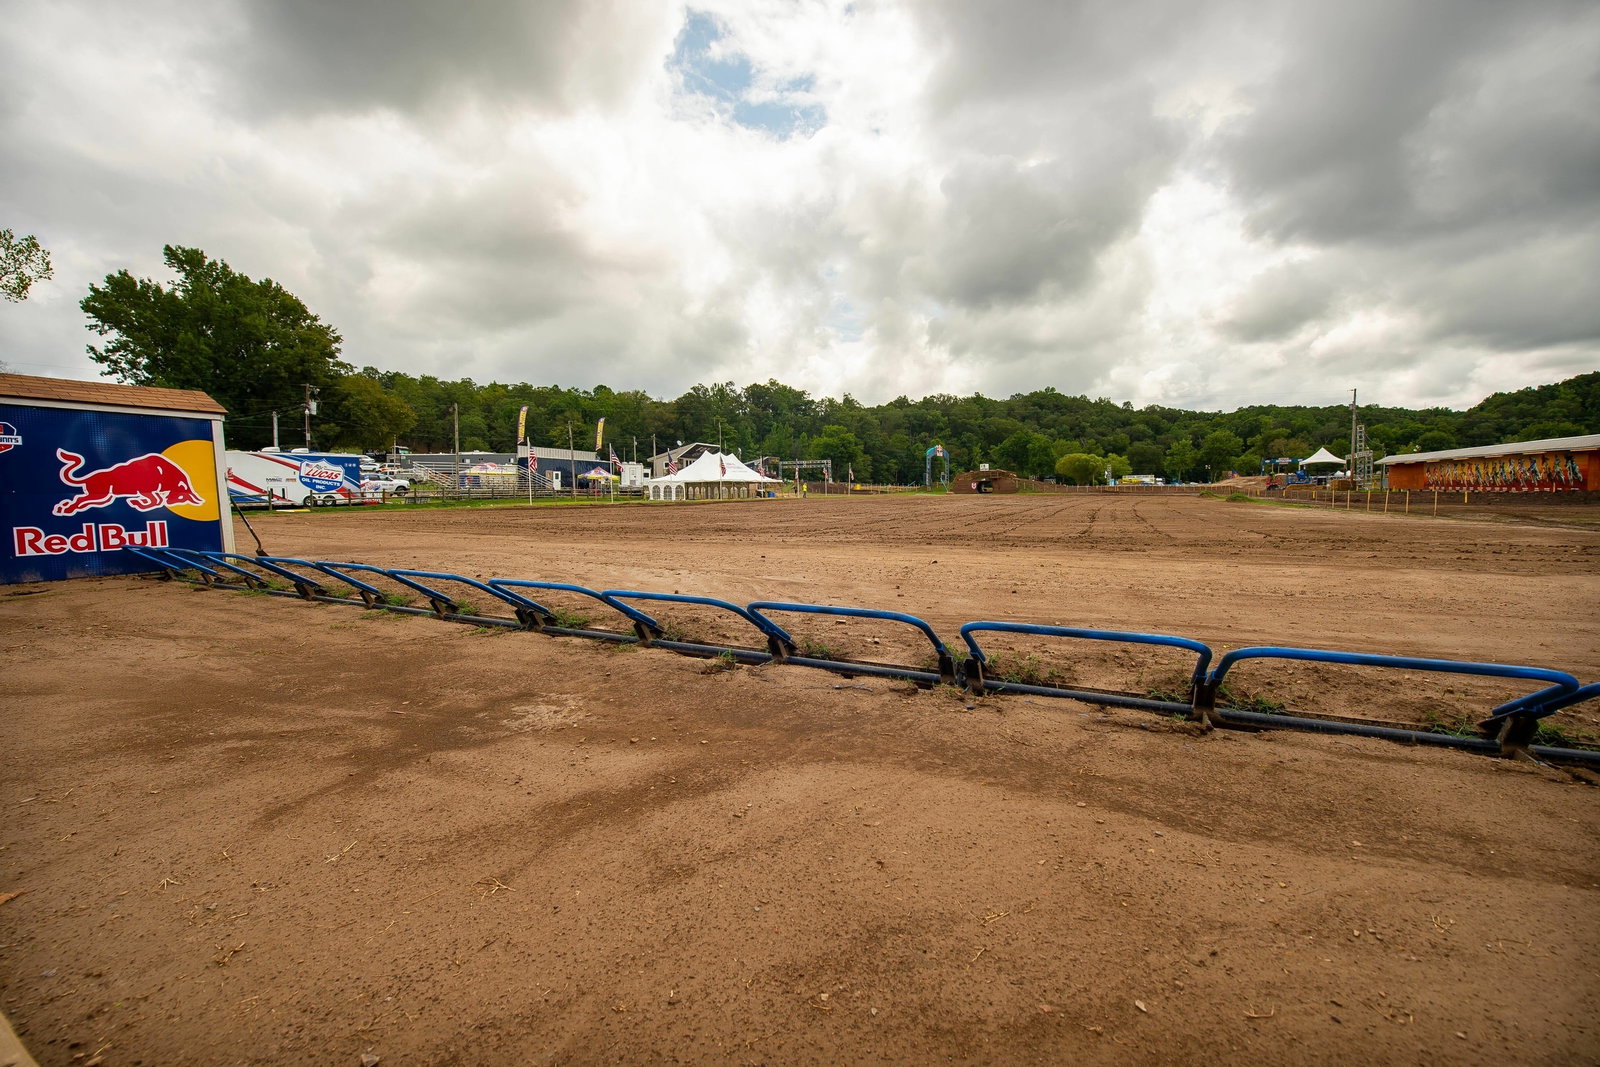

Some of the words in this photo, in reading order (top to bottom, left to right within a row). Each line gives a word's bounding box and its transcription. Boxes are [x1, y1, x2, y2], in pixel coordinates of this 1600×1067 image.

[305, 469, 341, 479] LUCAS
[13, 523, 97, 556] Red
[99, 520, 169, 551] Bull
